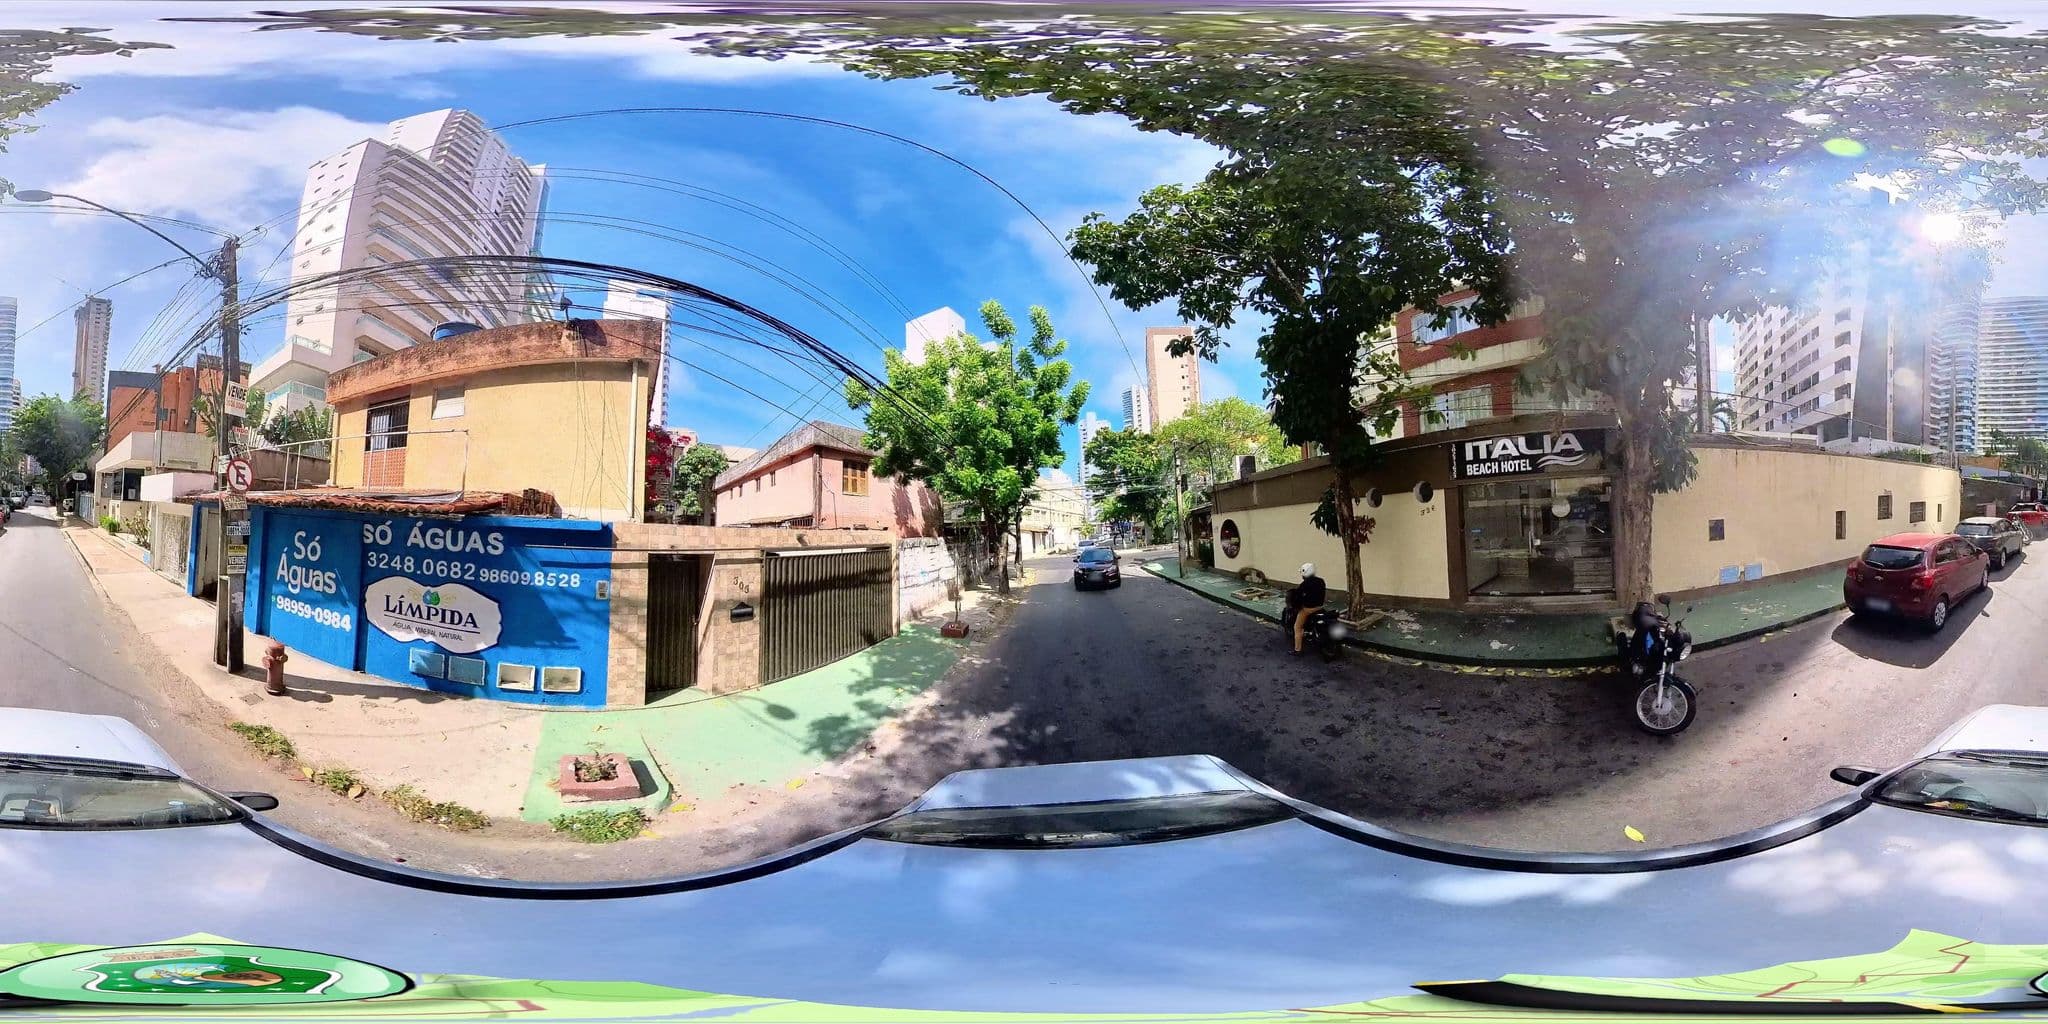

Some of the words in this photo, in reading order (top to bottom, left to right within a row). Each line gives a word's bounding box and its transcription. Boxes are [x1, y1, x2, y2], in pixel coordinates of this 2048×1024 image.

[1465, 433, 1583, 461] ITALIA
[1466, 461, 1498, 476] BEACH
[1501, 459, 1532, 473] HOTEL
[294, 531, 321, 561] Só
[363, 520, 393, 546] SÓ
[407, 522, 505, 555] ÁGUAS
[277, 547, 337, 594] Águas
[367, 552, 475, 581] 3248.0682
[480, 569, 581, 588] 98609.8528
[276, 595, 352, 632] 98959-0984
[384, 594, 480, 629] LÍMPIDA
[415, 626, 437, 636] MINERAL
[439, 631, 464, 642] NATURAL
